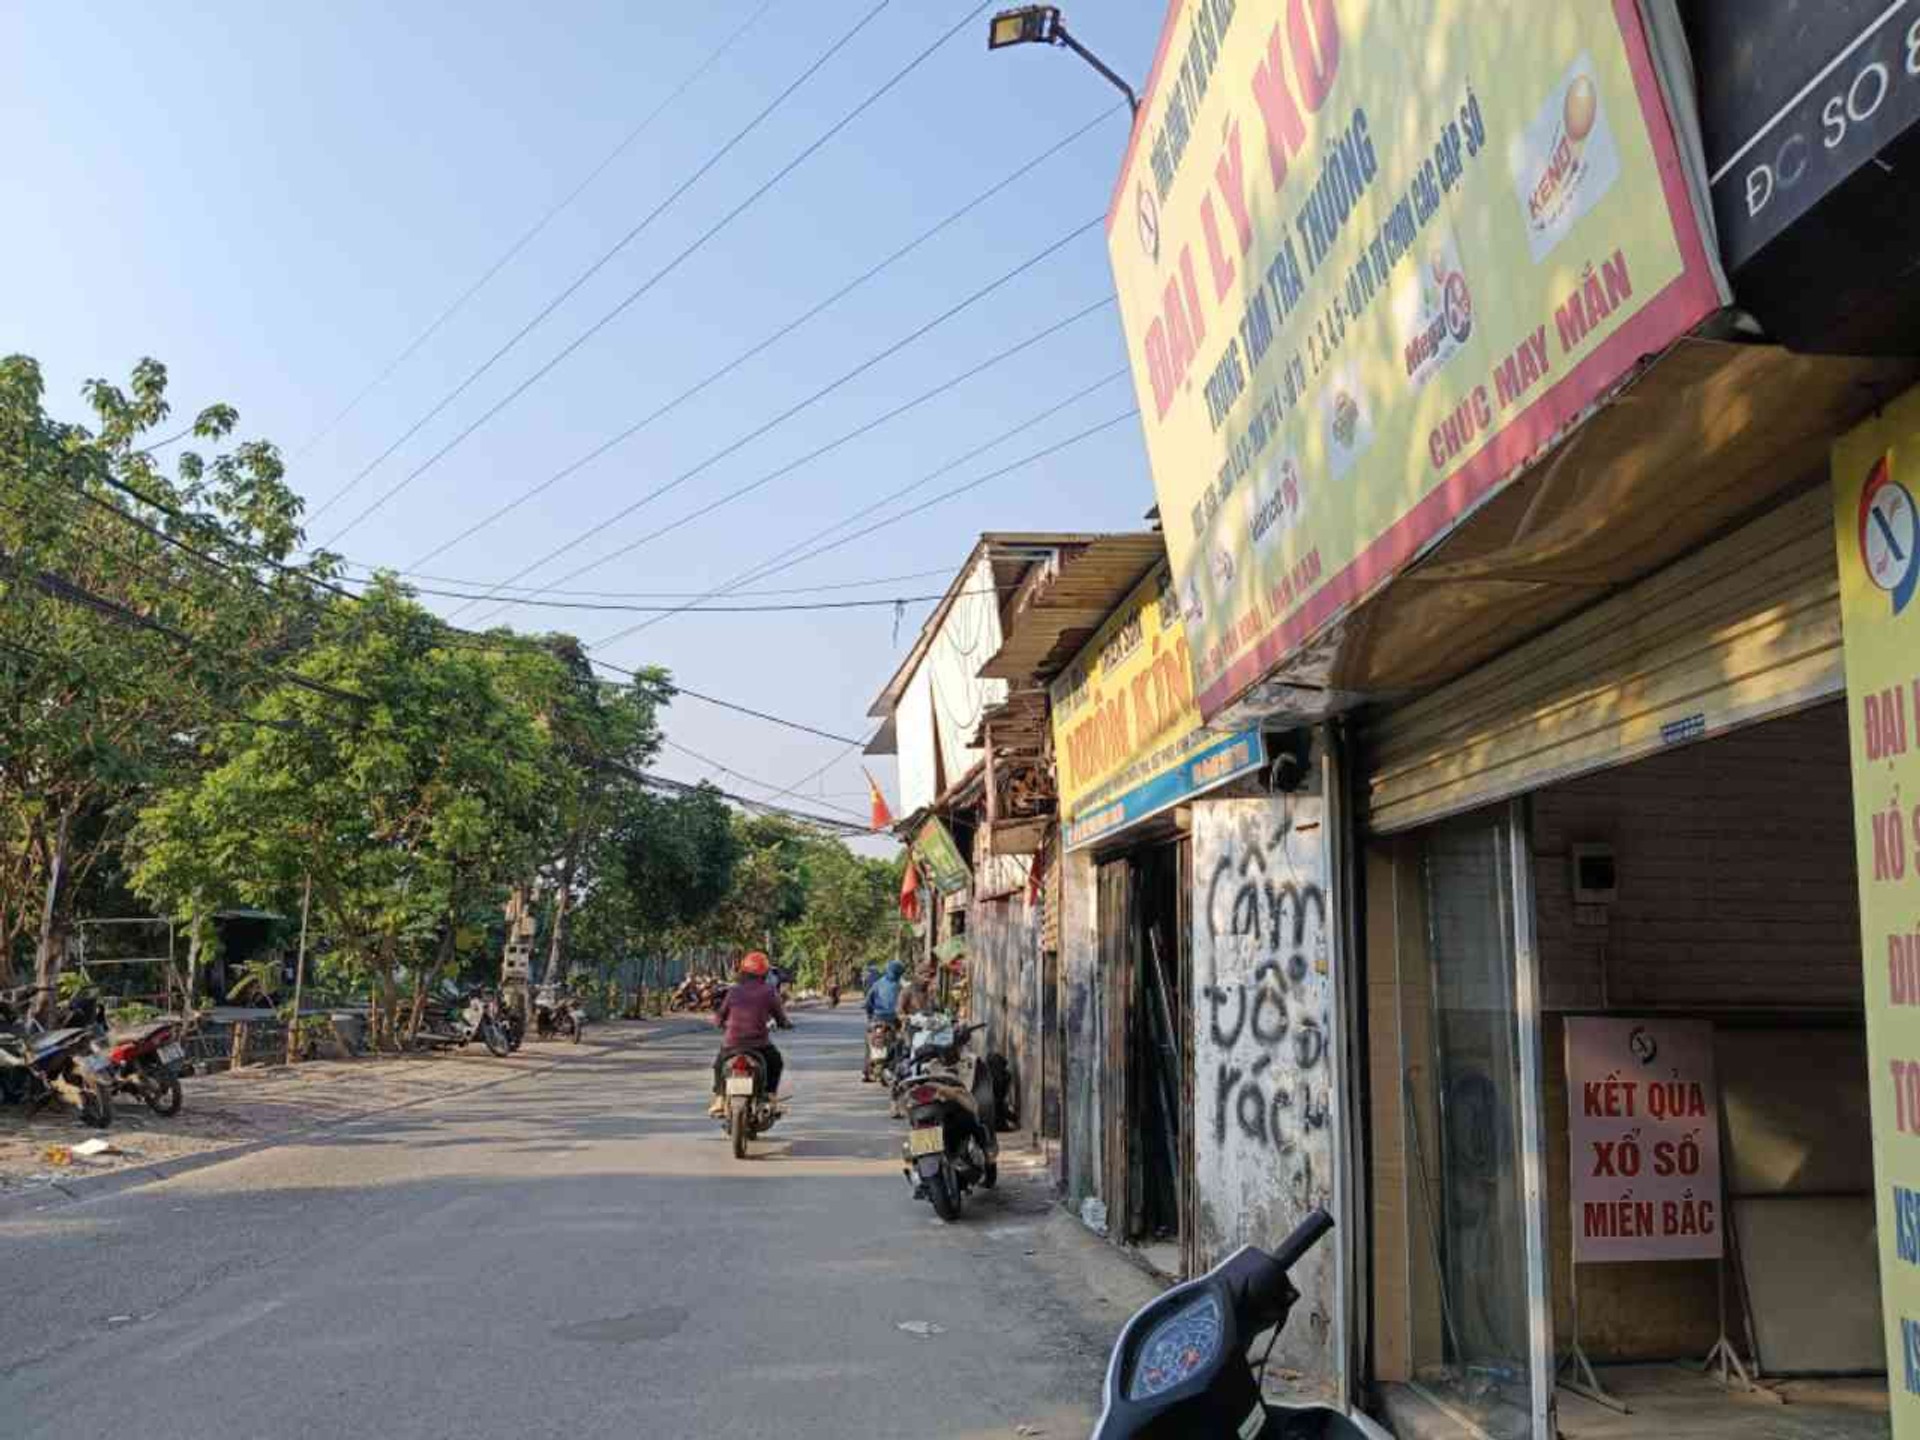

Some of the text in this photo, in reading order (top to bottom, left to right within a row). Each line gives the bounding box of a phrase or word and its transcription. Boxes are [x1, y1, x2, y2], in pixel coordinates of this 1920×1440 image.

[1144, 241, 1206, 421] ĐẠI
[1200, 109, 1253, 306] LÝ
[1493, 324, 1550, 410] MAY
[1555, 248, 1633, 354] MẮN
[1863, 684, 1907, 770] ĐẠI
[1583, 1069, 1637, 1118] KẾT
[1593, 1127, 1700, 1178] XỔ SỐ
[1661, 1188, 1714, 1236] BẮC
